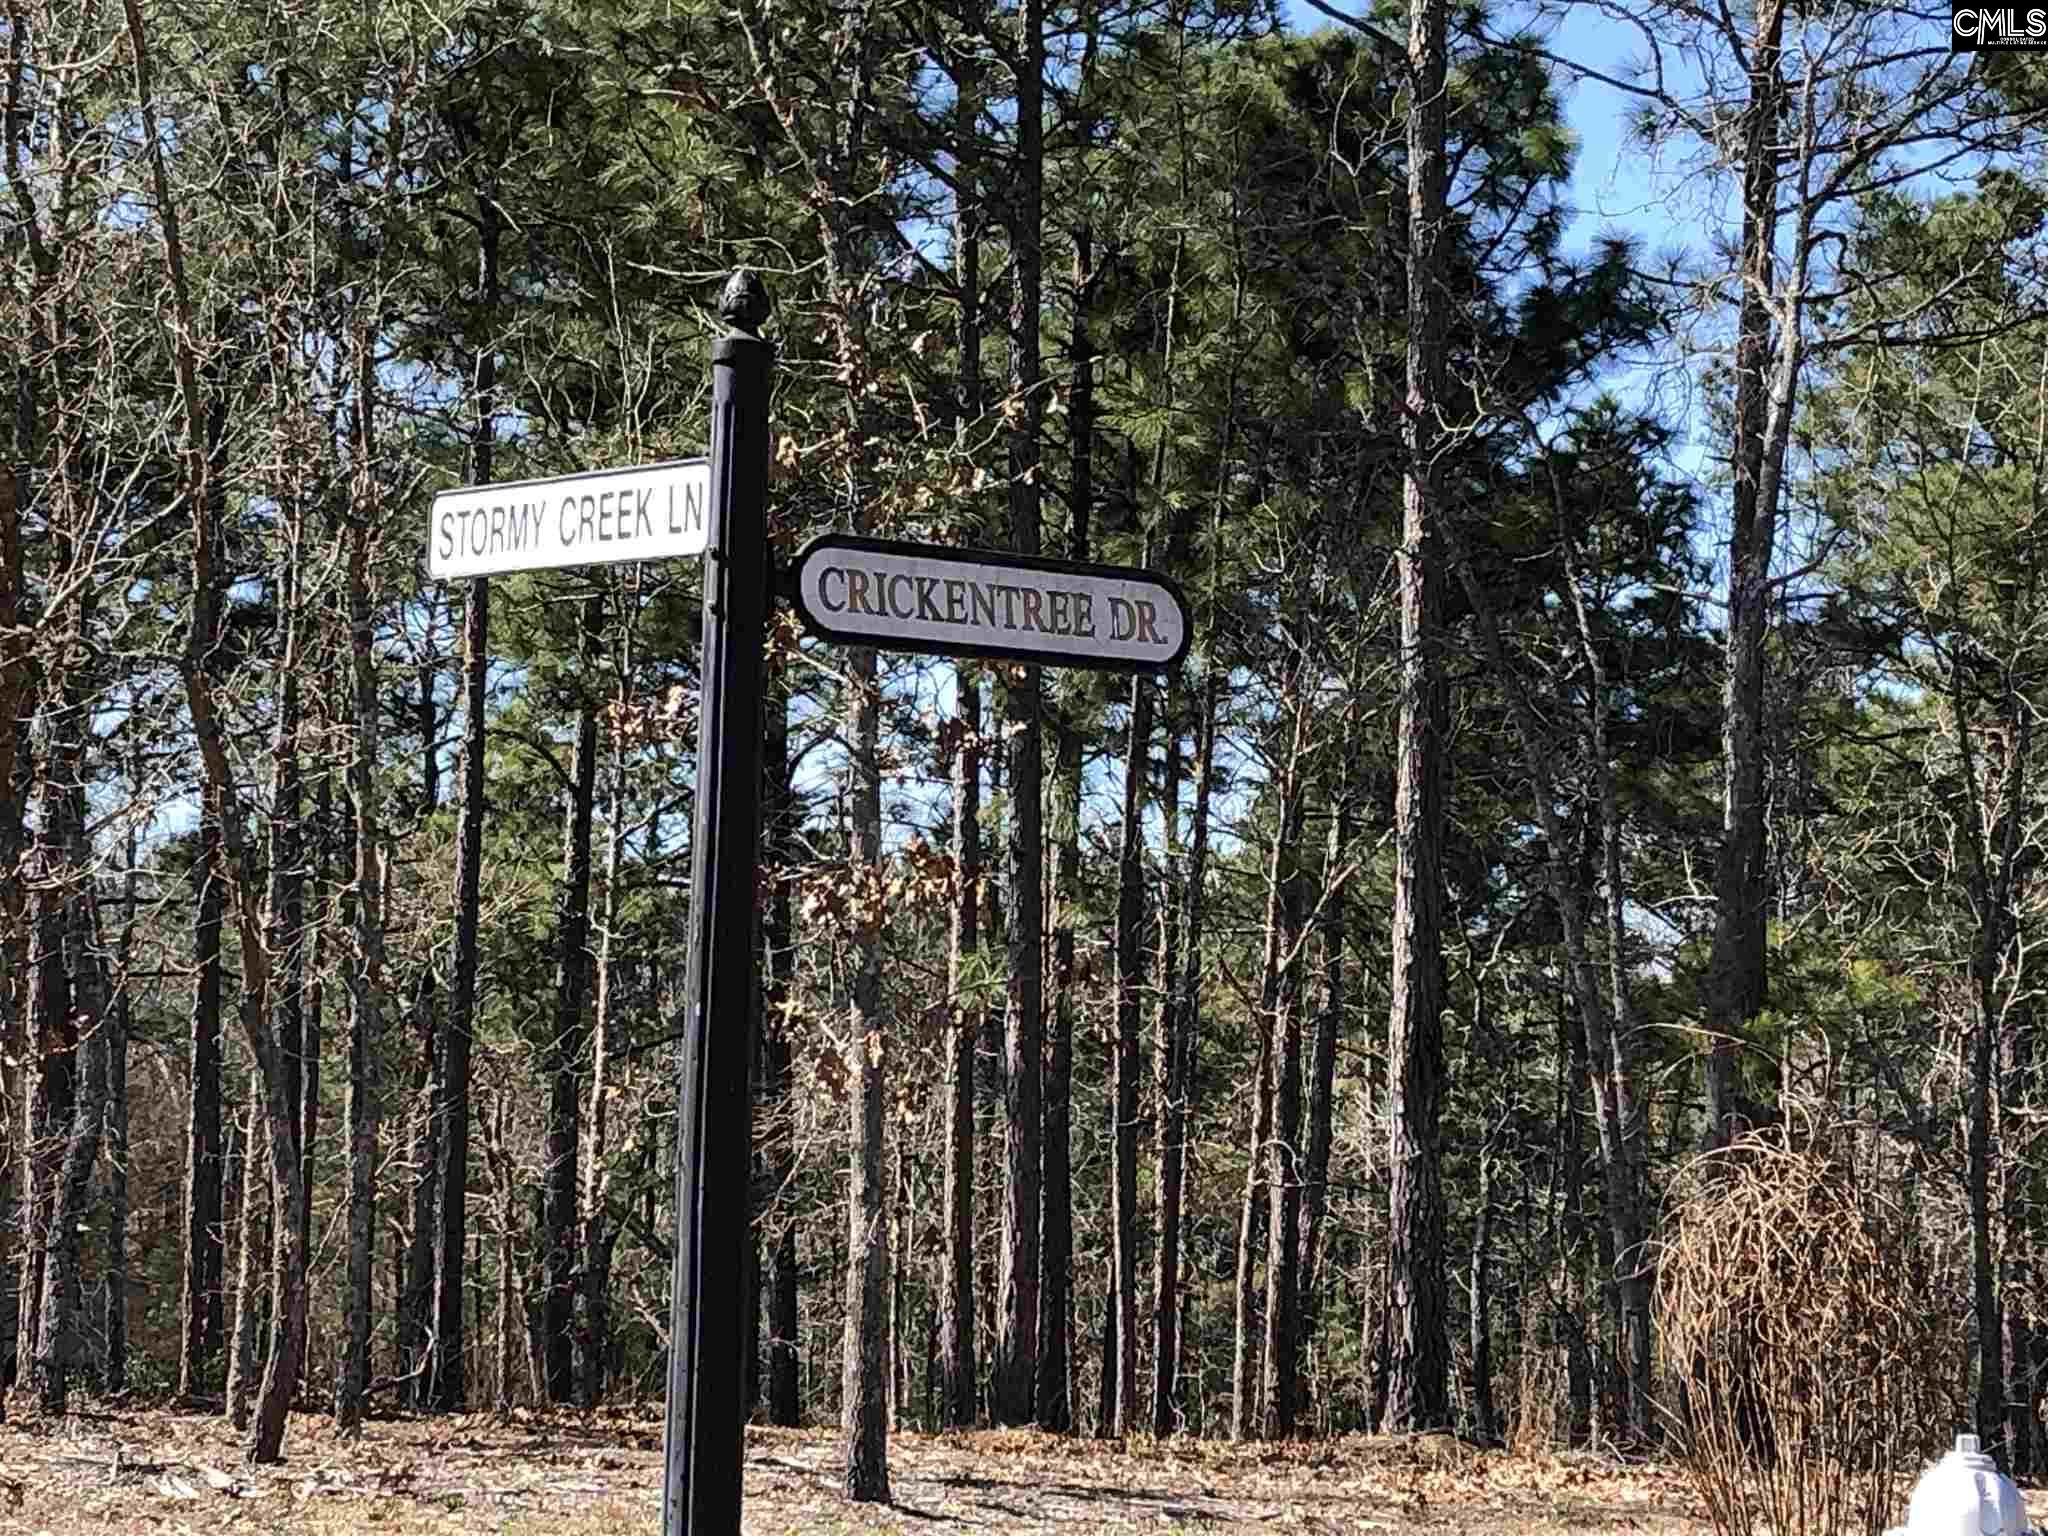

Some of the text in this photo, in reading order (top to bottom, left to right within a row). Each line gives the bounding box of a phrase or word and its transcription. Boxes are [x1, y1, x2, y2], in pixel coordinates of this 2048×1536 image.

[439, 482, 702, 560] STORMY CREEK LN
[818, 566, 1168, 644] CRICKENTREE DR.
